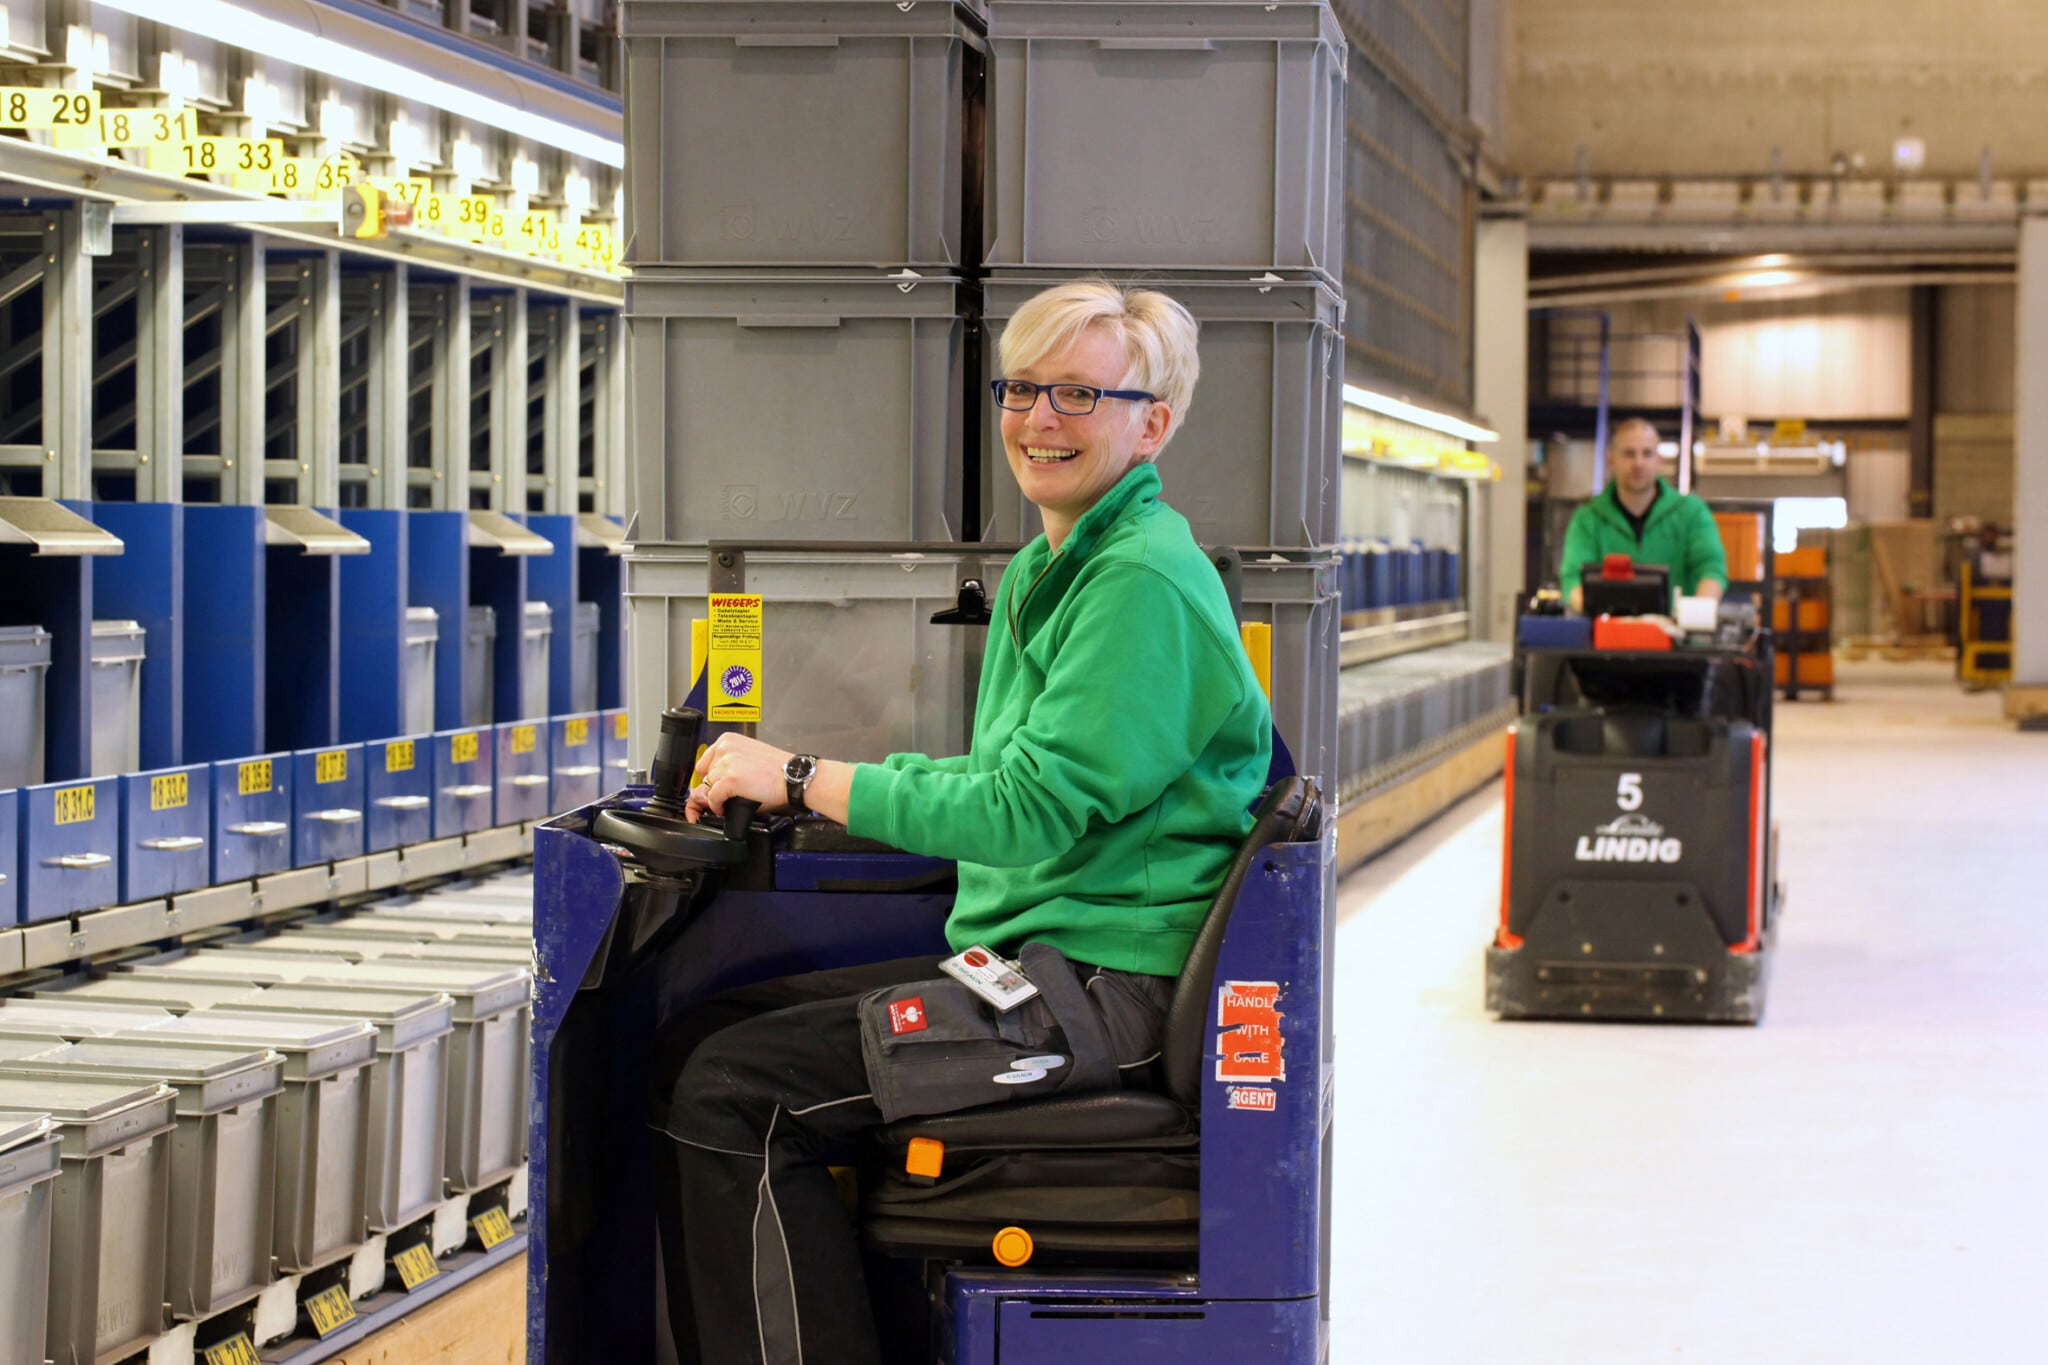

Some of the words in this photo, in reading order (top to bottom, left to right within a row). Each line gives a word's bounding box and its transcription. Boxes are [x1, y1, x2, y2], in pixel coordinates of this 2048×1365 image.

[0, 92, 26, 122] 8
[52, 94, 91, 125] 29
[101, 114, 130, 142] 18
[153, 112, 187, 141] 31
[183, 142, 216, 168] 18
[238, 143, 272, 170] 33
[319, 165, 350, 189] 35
[458, 199, 487, 223] 39
[521, 216, 547, 238] 41
[576, 230, 602, 251] 43
[778, 491, 859, 521] WVZ
[712, 598, 760, 608] WIEGERS
[730, 673, 746, 688] 2014
[152, 776, 164, 808] 18
[166, 774, 186, 805] 33.C
[1616, 772, 1643, 811] 5
[56, 791, 69, 823] 18
[71, 787, 93, 819] 31.C
[1575, 835, 1682, 863] LINDIG
[1226, 996, 1274, 1009] HANDL
[1236, 1024, 1269, 1036] WITH
[1233, 1090, 1275, 1106] RGENT
[308, 1300, 329, 1331] 18
[323, 1287, 354, 1323] 29.A
